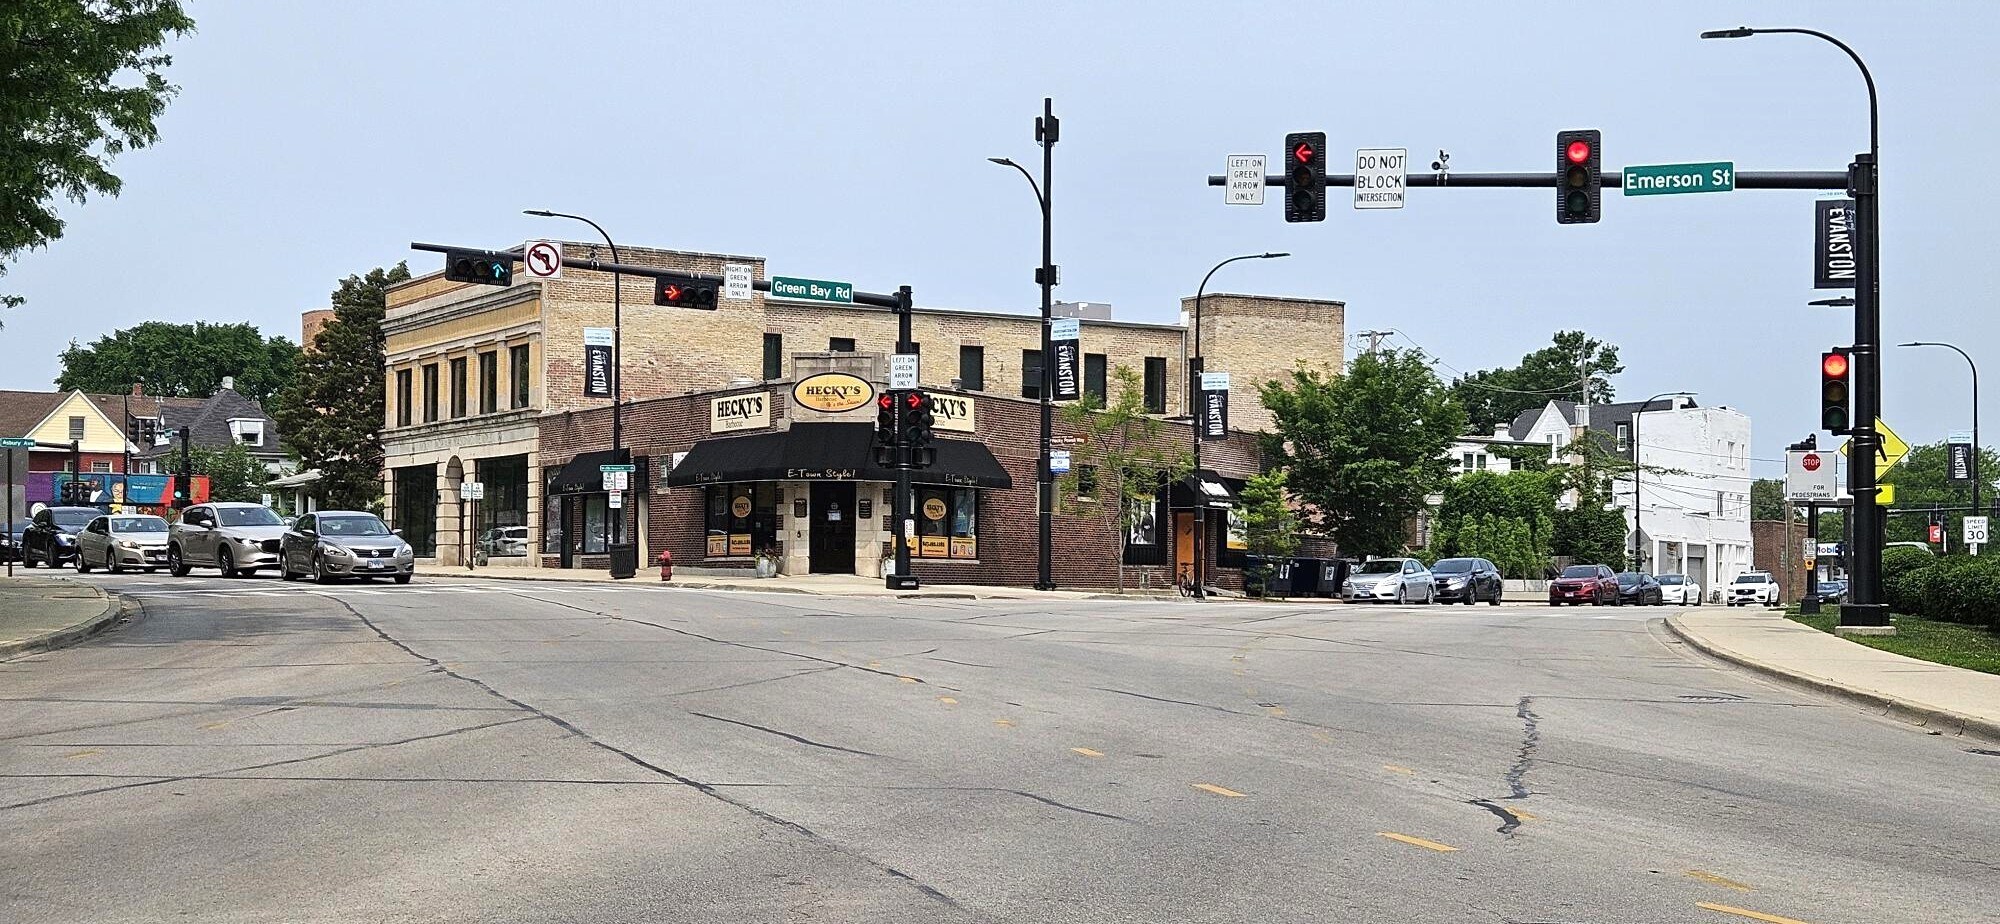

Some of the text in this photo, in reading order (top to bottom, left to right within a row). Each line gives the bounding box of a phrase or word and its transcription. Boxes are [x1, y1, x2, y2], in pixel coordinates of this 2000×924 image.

[1231, 159, 1262, 168] LEFT ON
[1359, 155, 1404, 169] DO NOT
[1233, 170, 1258, 179] GREEN
[1626, 169, 1731, 190] Emerson St
[1232, 181, 1259, 190] ARROW
[1358, 175, 1402, 189] BLOCK
[1234, 192, 1255, 201] ONLY
[1356, 192, 1403, 202] INTERSECTION
[1828, 208, 1856, 279] EVANSTON
[774, 280, 850, 300] Green Bay Rd
[592, 349, 608, 394] EVANSTON
[1058, 345, 1076, 395] EVANSTON
[805, 386, 861, 400] HECKY'S
[717, 396, 763, 419] HECKY'S
[932, 397, 967, 420] CKY'S
[1208, 394, 1225, 436] EVANSTON
[1803, 458, 1820, 466] STOP
[1954, 446, 1968, 479] EVANSTON
[787, 468, 856, 481] E-Town Style!
[1967, 530, 1985, 540] 30
